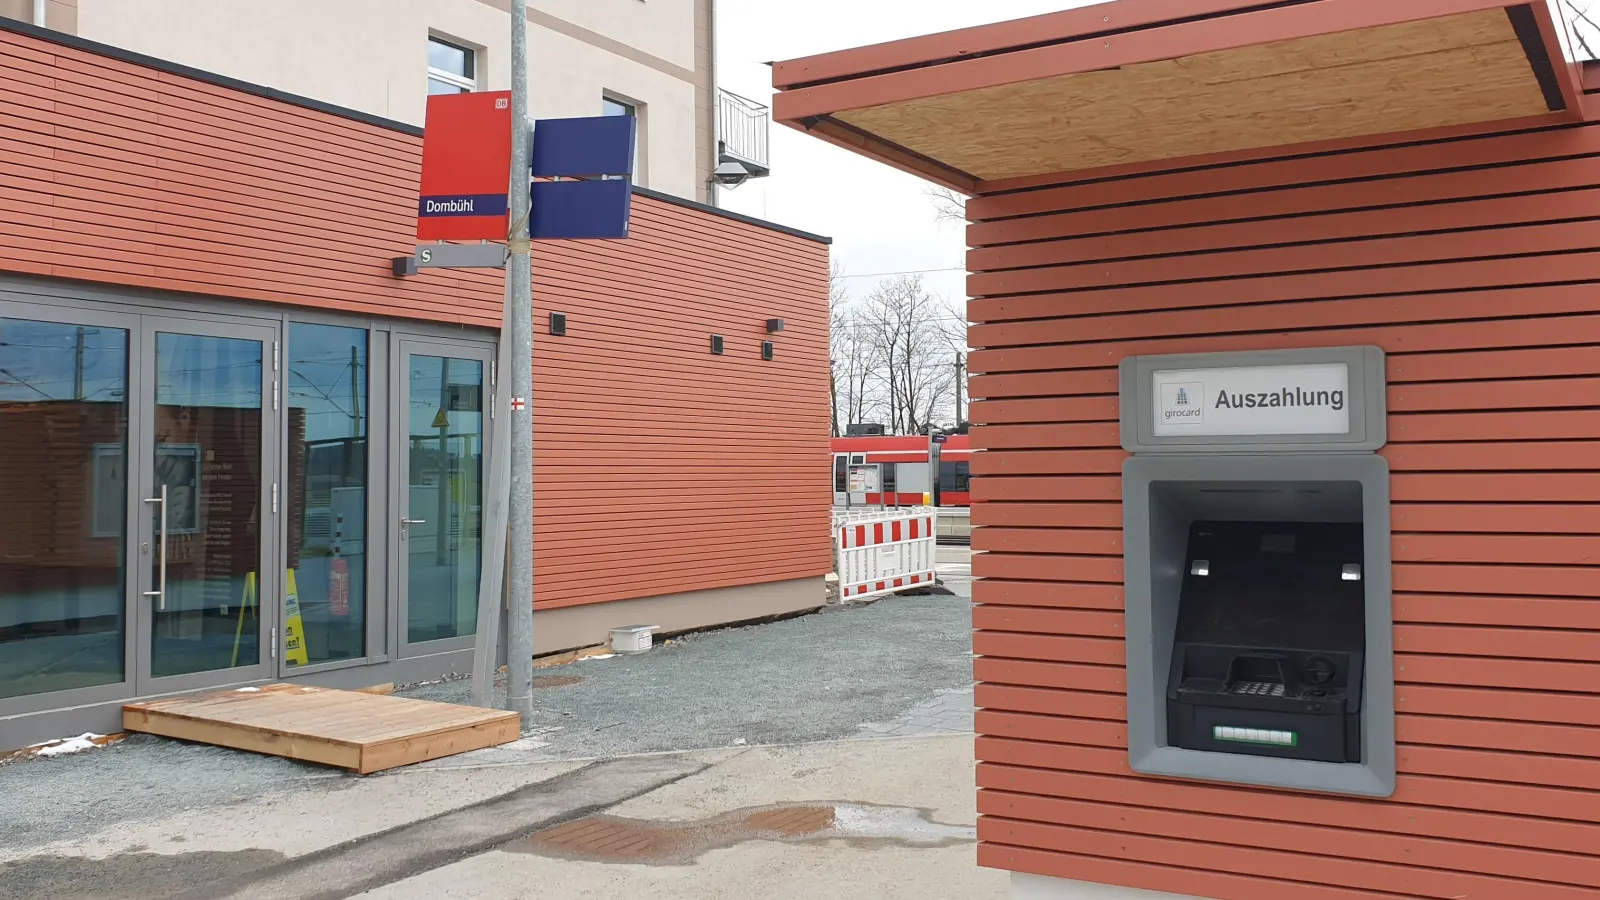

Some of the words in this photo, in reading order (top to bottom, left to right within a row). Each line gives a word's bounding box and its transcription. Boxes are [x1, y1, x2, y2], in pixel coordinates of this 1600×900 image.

[496, 99, 507, 108] DB
[426, 199, 474, 213] Dombühl
[421, 249, 431, 262] S
[1215, 387, 1343, 411] Auszahlung
[1164, 408, 1200, 420] girocard
